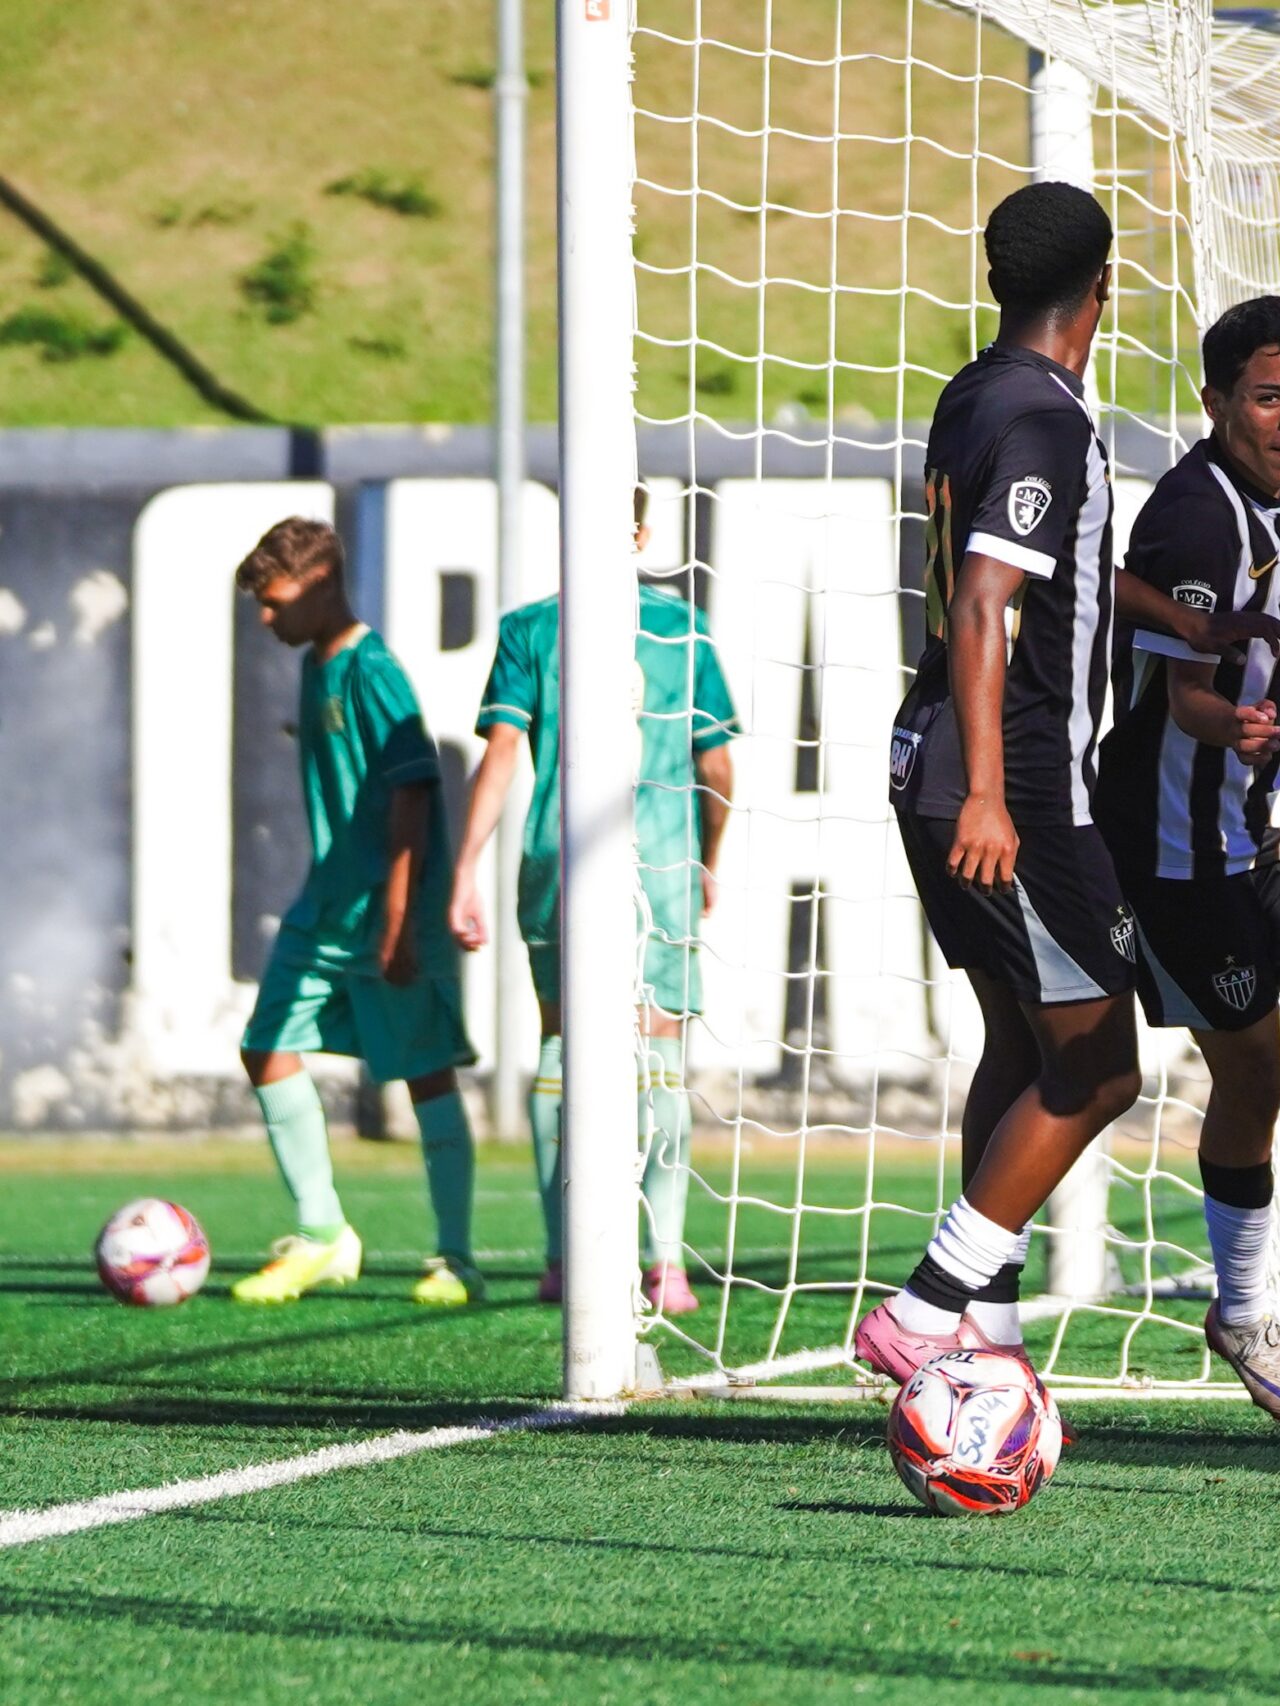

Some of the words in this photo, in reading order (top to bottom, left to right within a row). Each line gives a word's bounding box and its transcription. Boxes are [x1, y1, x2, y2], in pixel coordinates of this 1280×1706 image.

[1023, 488, 1044, 505] M2
[1184, 591, 1205, 605] M2
[1219, 970, 1250, 985] CAM
